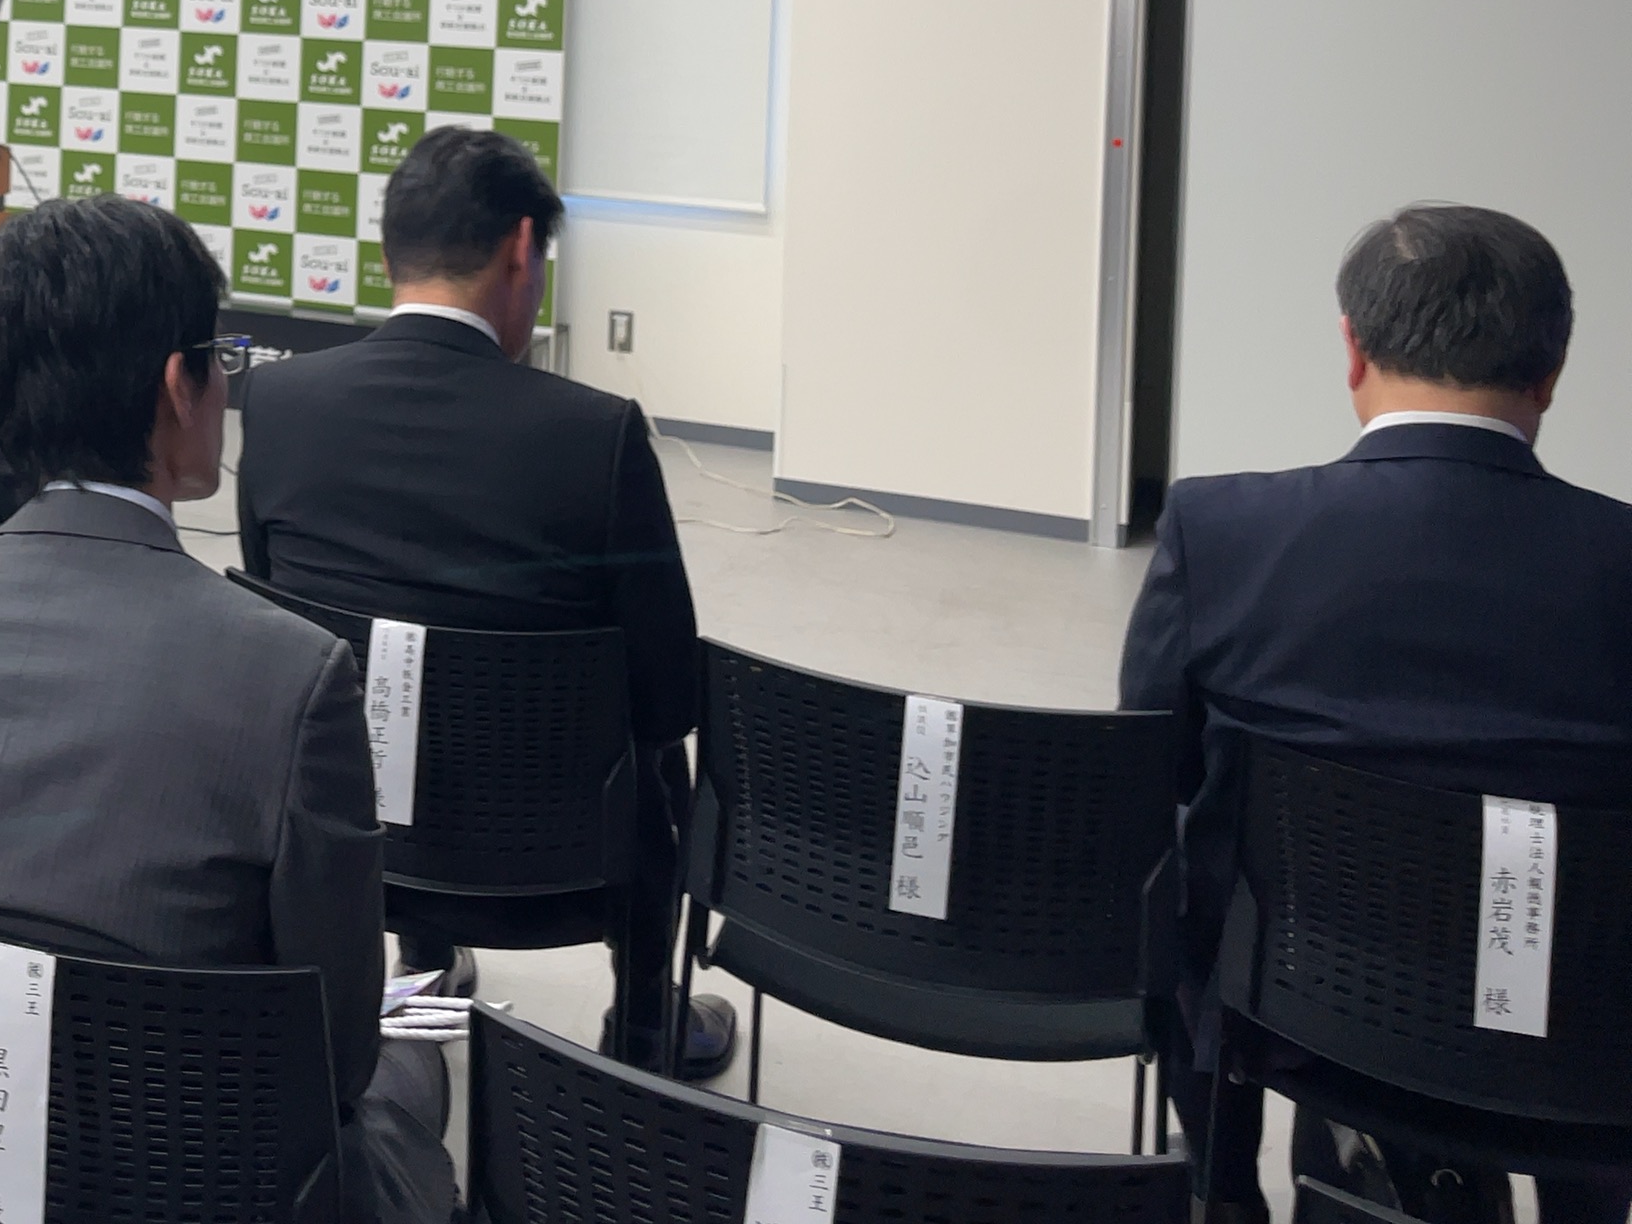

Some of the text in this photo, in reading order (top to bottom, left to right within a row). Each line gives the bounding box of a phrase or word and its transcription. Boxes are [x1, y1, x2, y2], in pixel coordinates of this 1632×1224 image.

[1487, 867, 1518, 956] 赤岩茂
[1483, 986, 1512, 1016] 様
